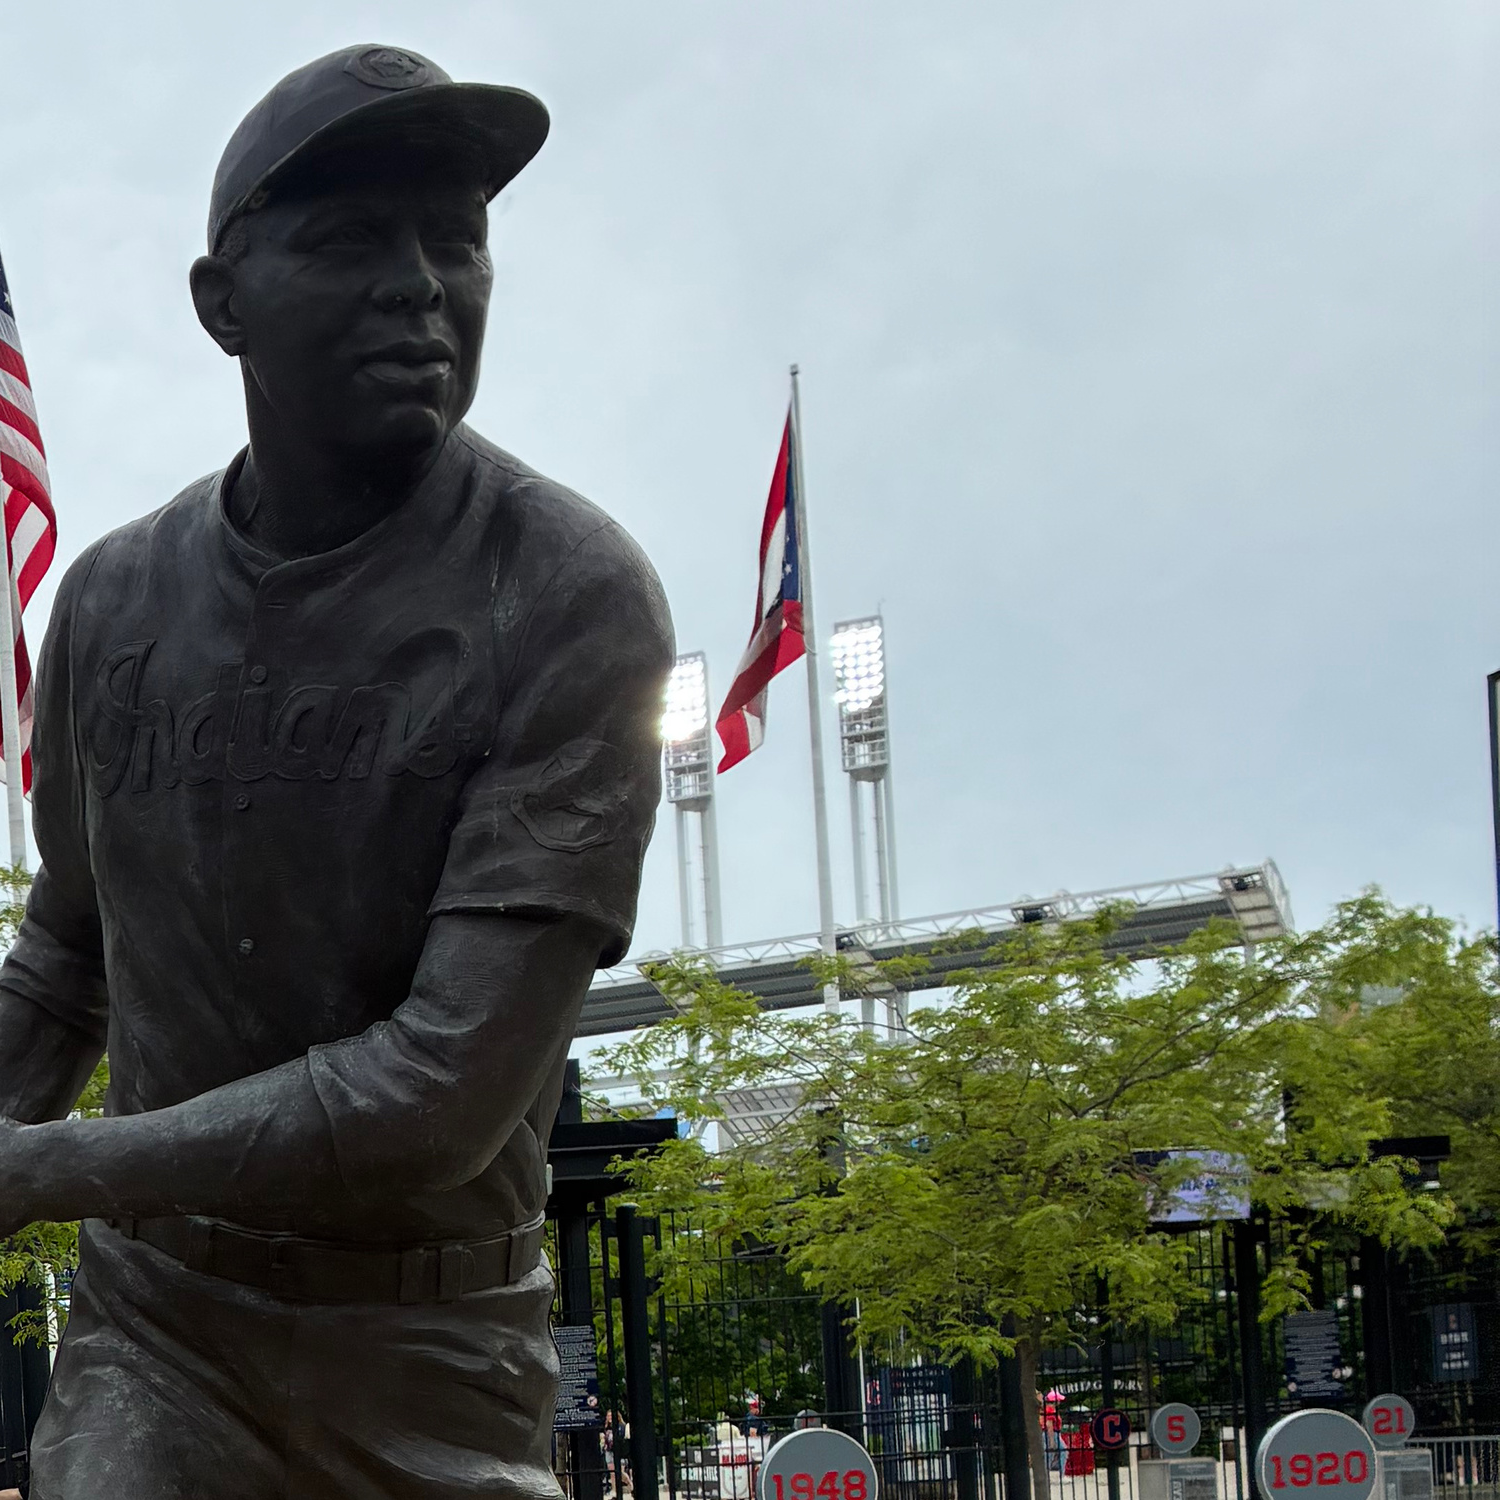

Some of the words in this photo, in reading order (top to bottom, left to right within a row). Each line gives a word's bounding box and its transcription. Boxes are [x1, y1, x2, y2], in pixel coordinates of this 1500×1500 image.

[1103, 1414, 1122, 1443] C
[1166, 1415, 1187, 1443] 5
[1372, 1406, 1408, 1435] 21
[1269, 1450, 1369, 1490] 1920
